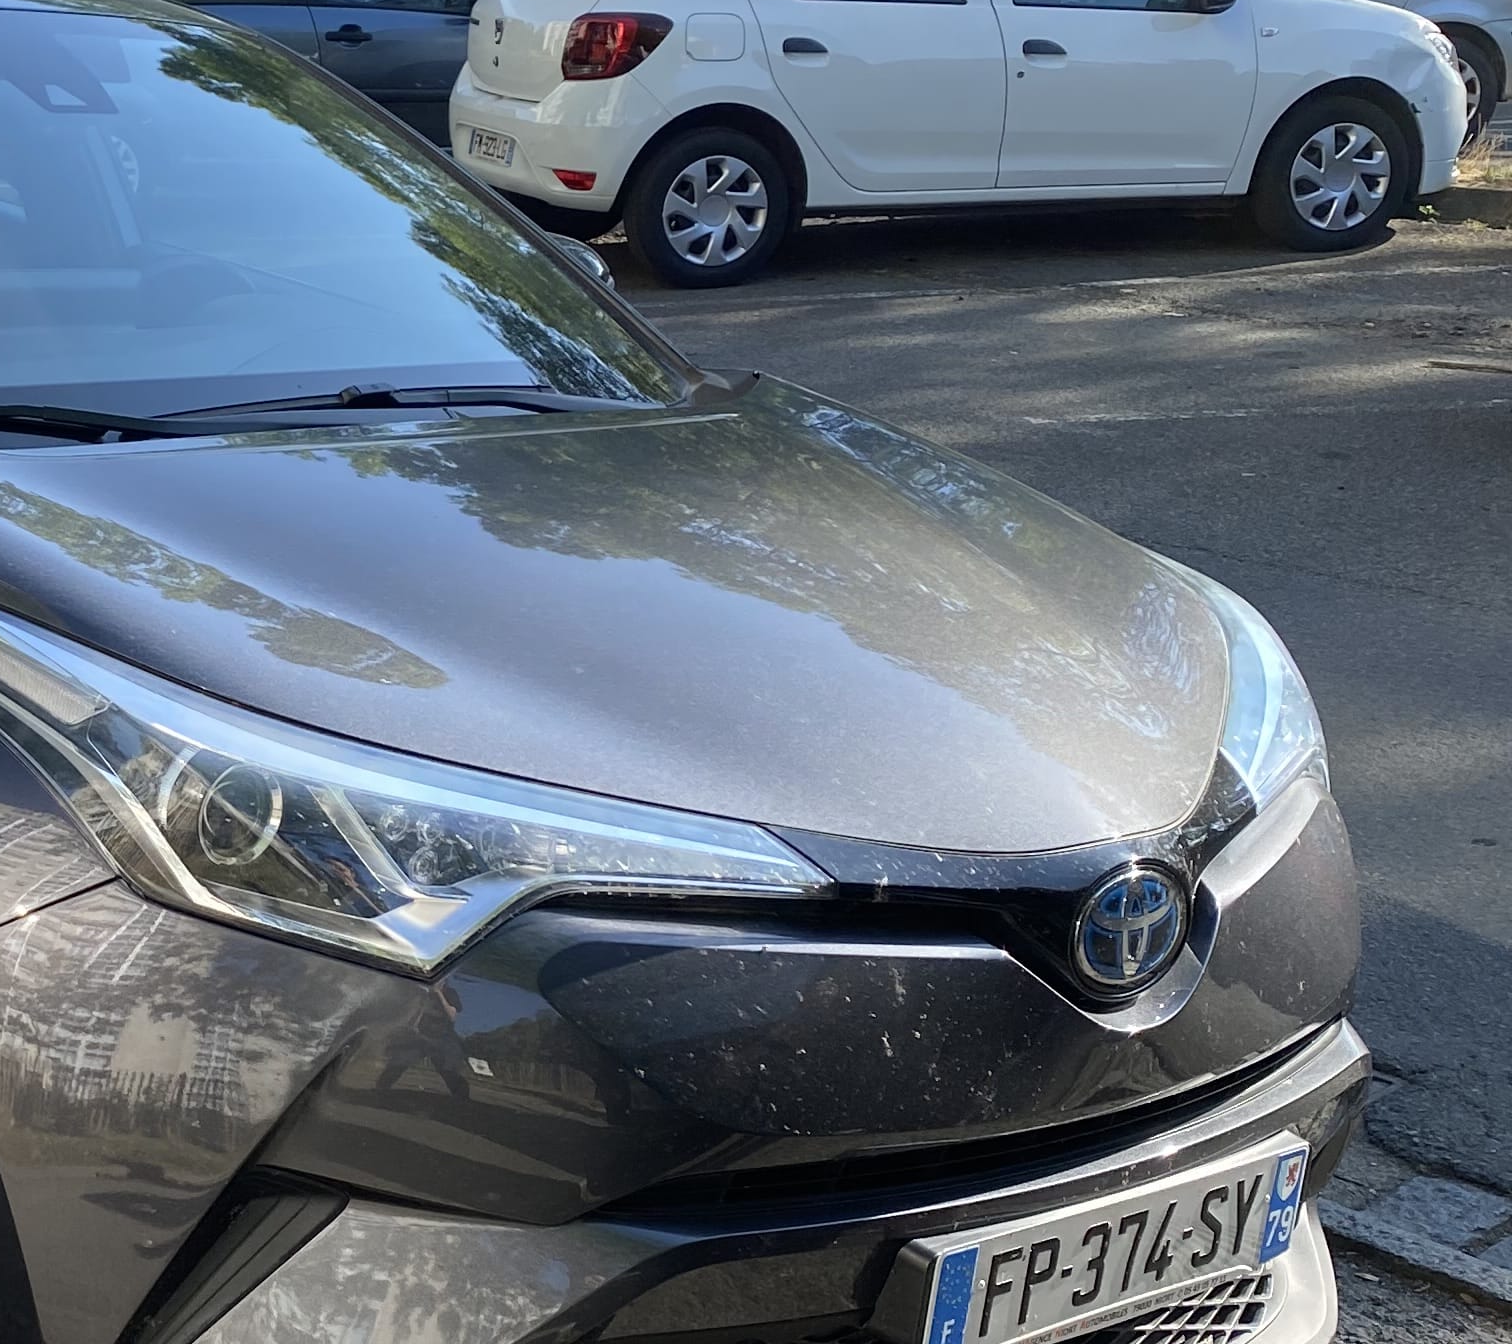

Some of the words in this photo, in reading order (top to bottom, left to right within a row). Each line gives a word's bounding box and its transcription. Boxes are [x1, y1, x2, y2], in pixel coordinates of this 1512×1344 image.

[1265, 1205, 1294, 1247] 79
[978, 1173, 1264, 1339] FP-374-SY
[940, 1318, 956, 1344] F
